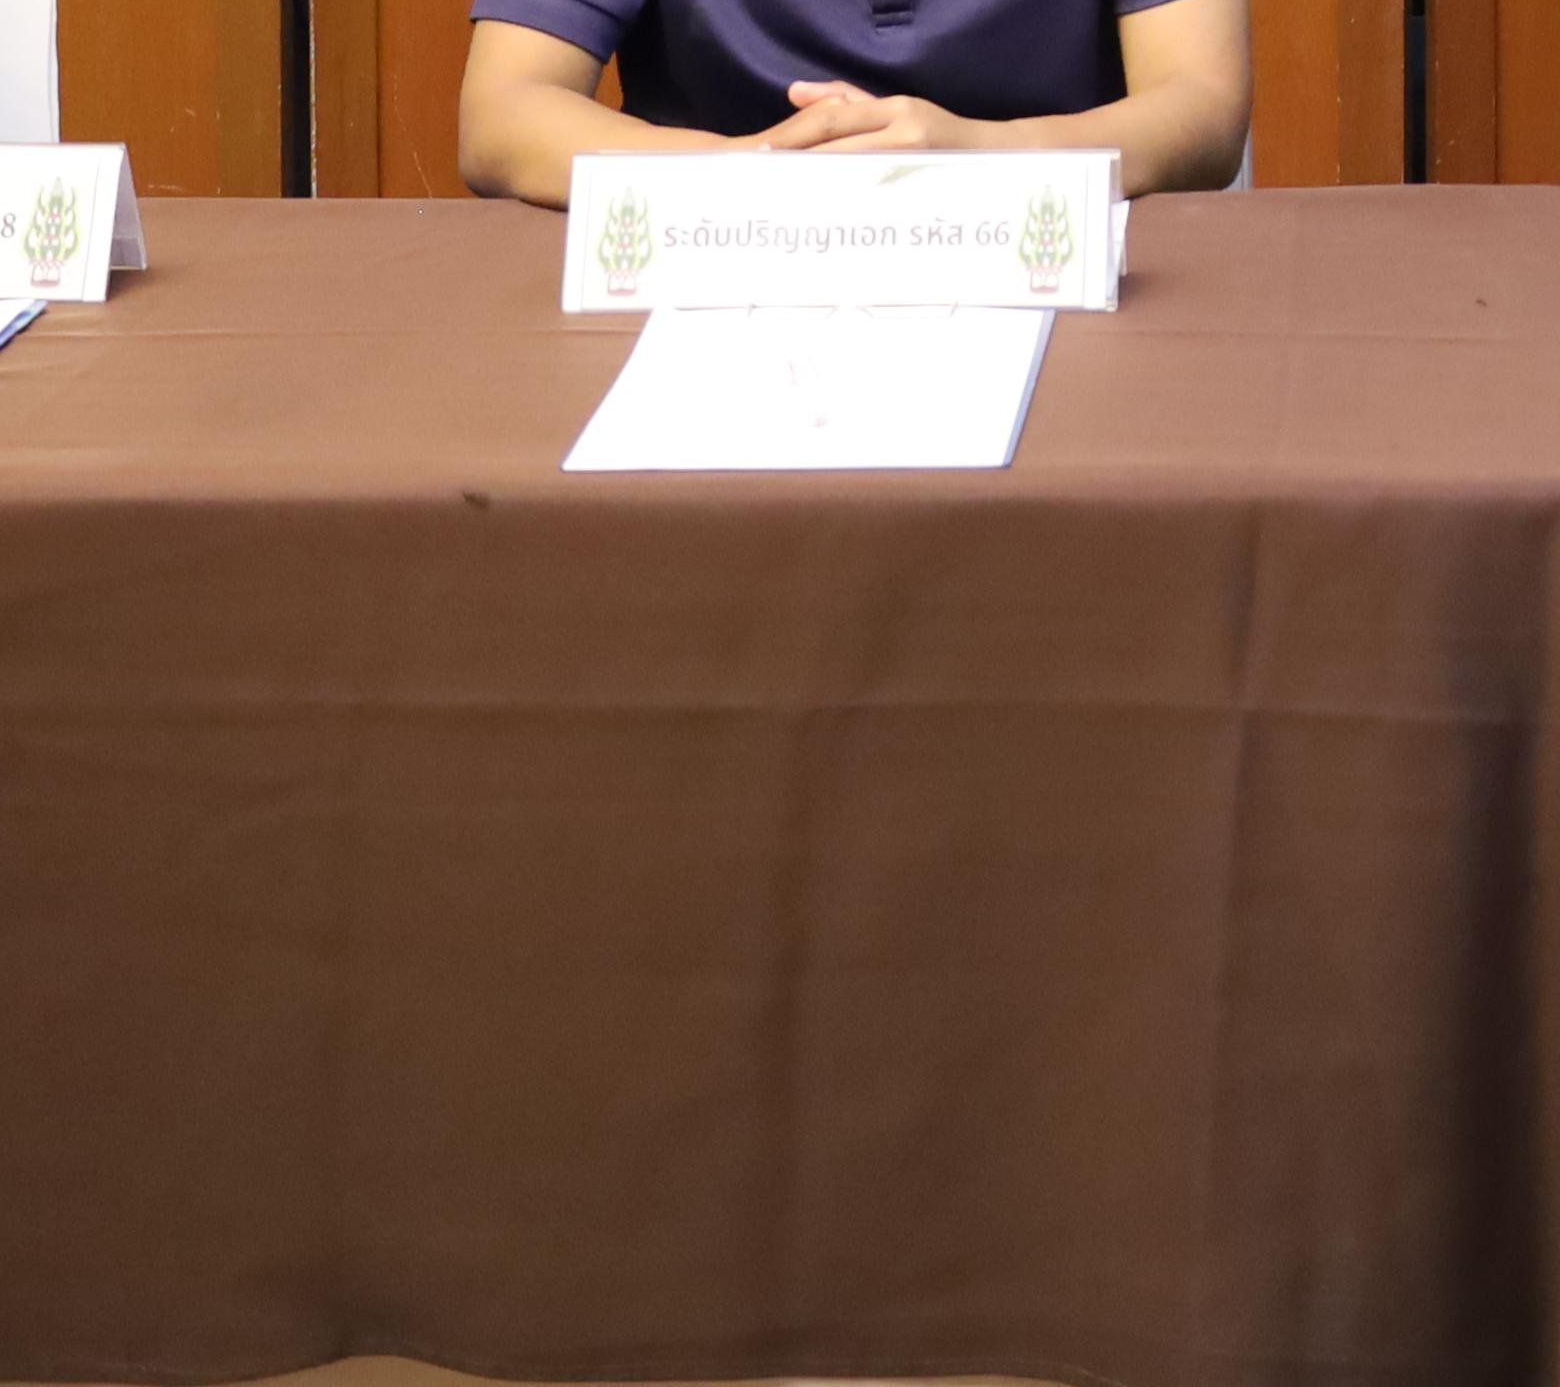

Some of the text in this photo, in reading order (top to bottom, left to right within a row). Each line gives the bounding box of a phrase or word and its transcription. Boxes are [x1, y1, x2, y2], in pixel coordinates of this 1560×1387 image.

[664, 217, 1010, 254] ระดับปริญญาเอก รหัส 66
